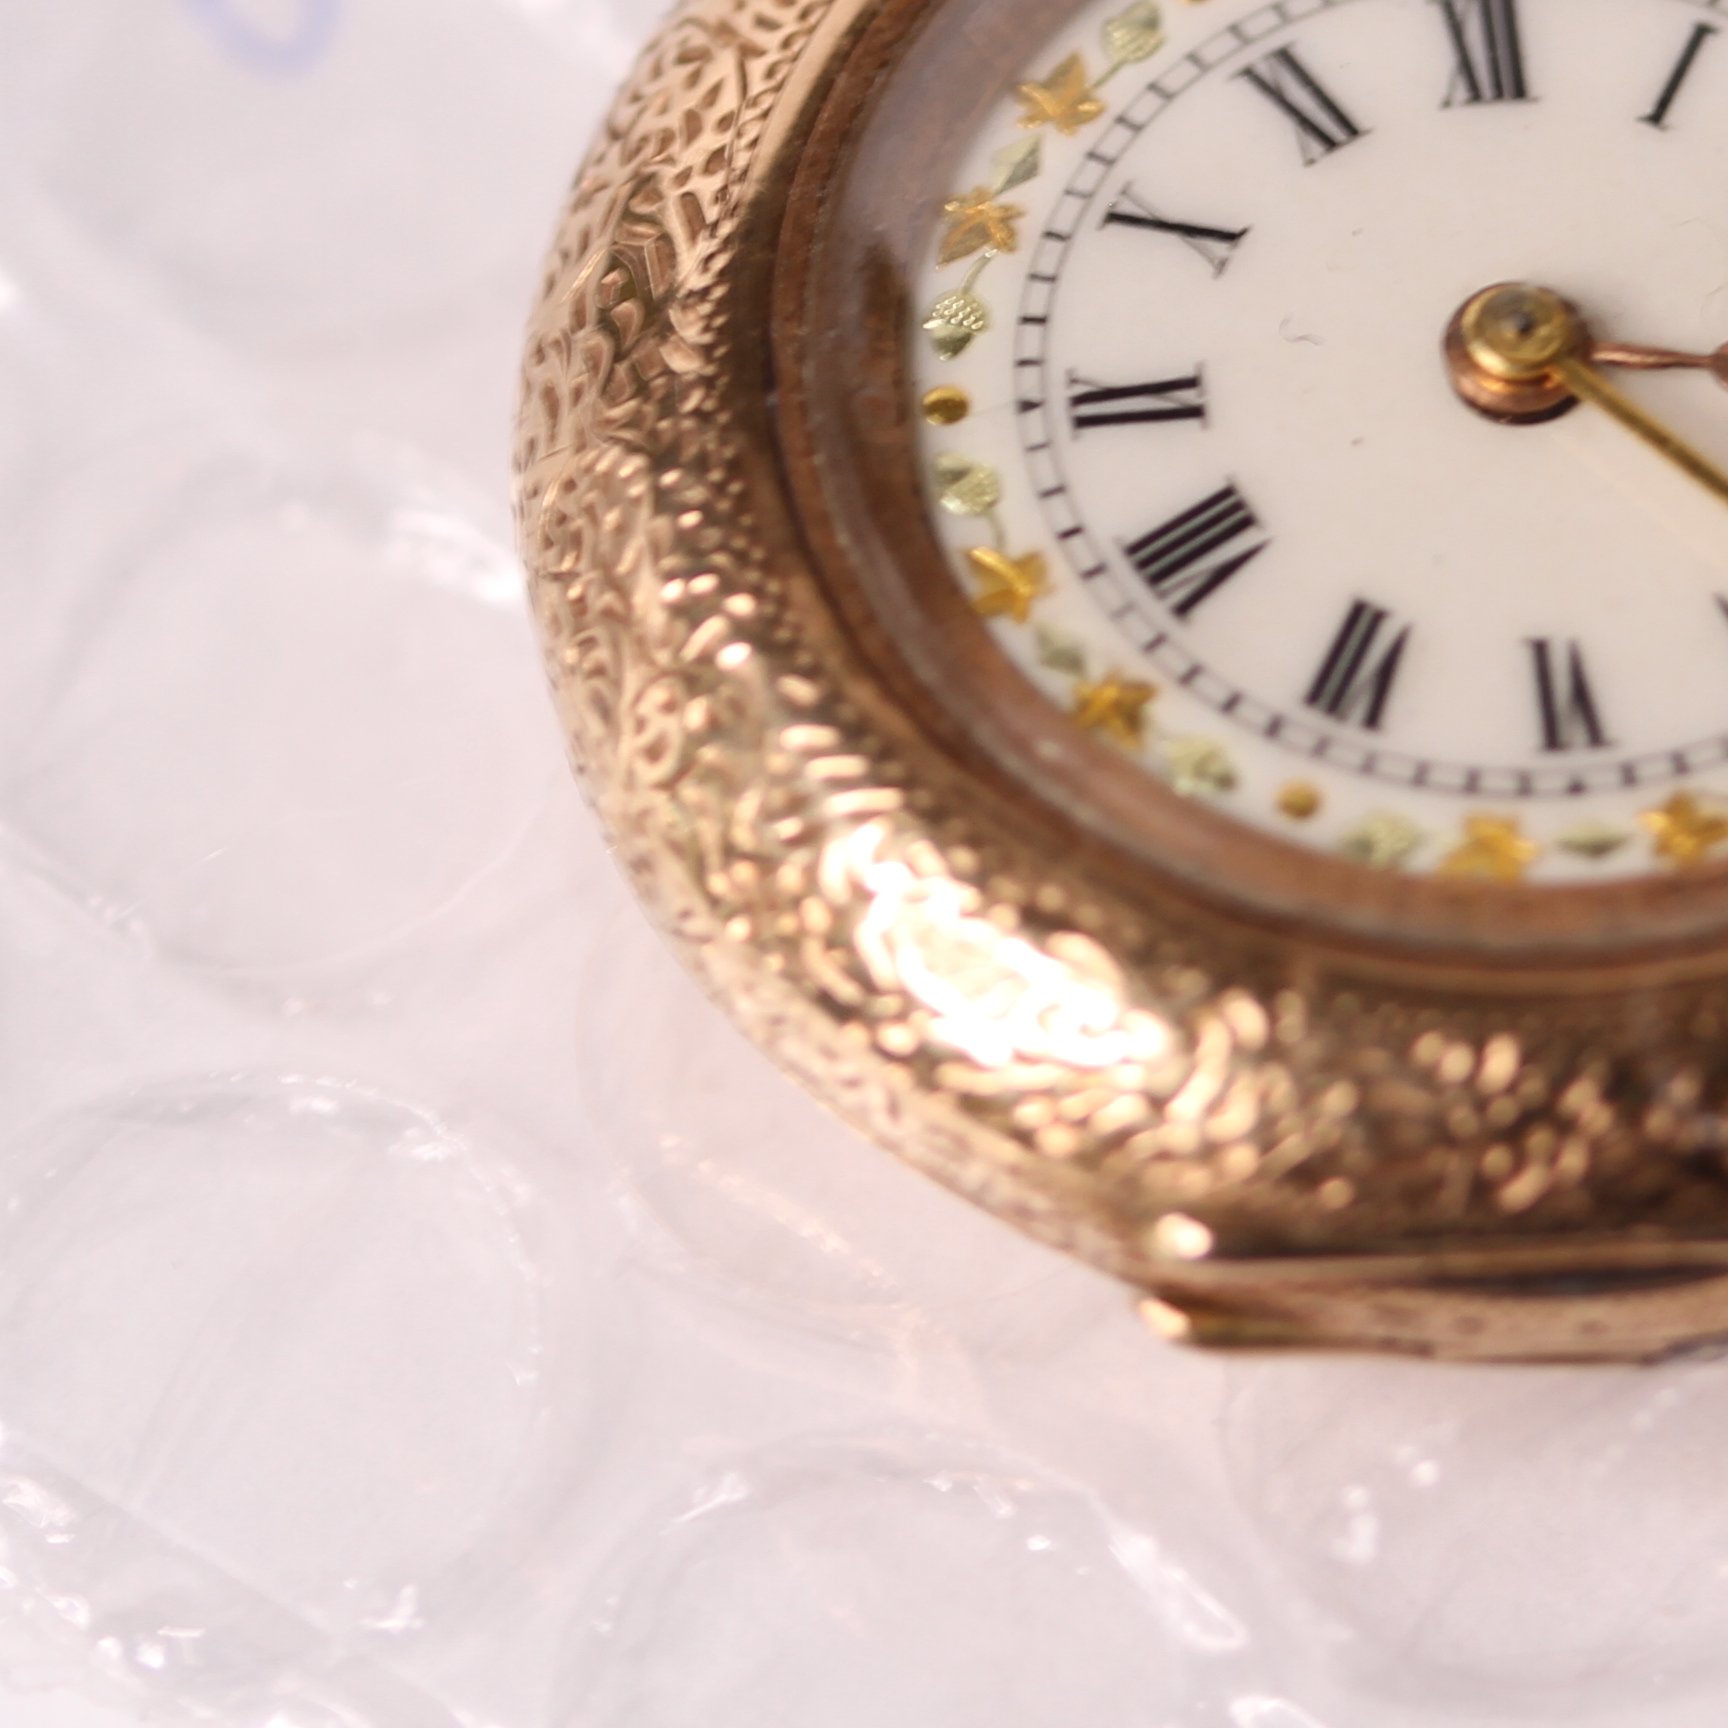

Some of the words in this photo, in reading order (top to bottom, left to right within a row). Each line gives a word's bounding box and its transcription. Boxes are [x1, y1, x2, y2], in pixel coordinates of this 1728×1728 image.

[1234, 44, 1370, 163] XI
[1640, 24, 1714, 127] I
[1099, 185, 1249, 276] X
[1070, 365, 1206, 437] IX
[1121, 479, 1270, 618] VIII
[1308, 600, 1411, 728] VII
[1527, 640, 1614, 750] VI
